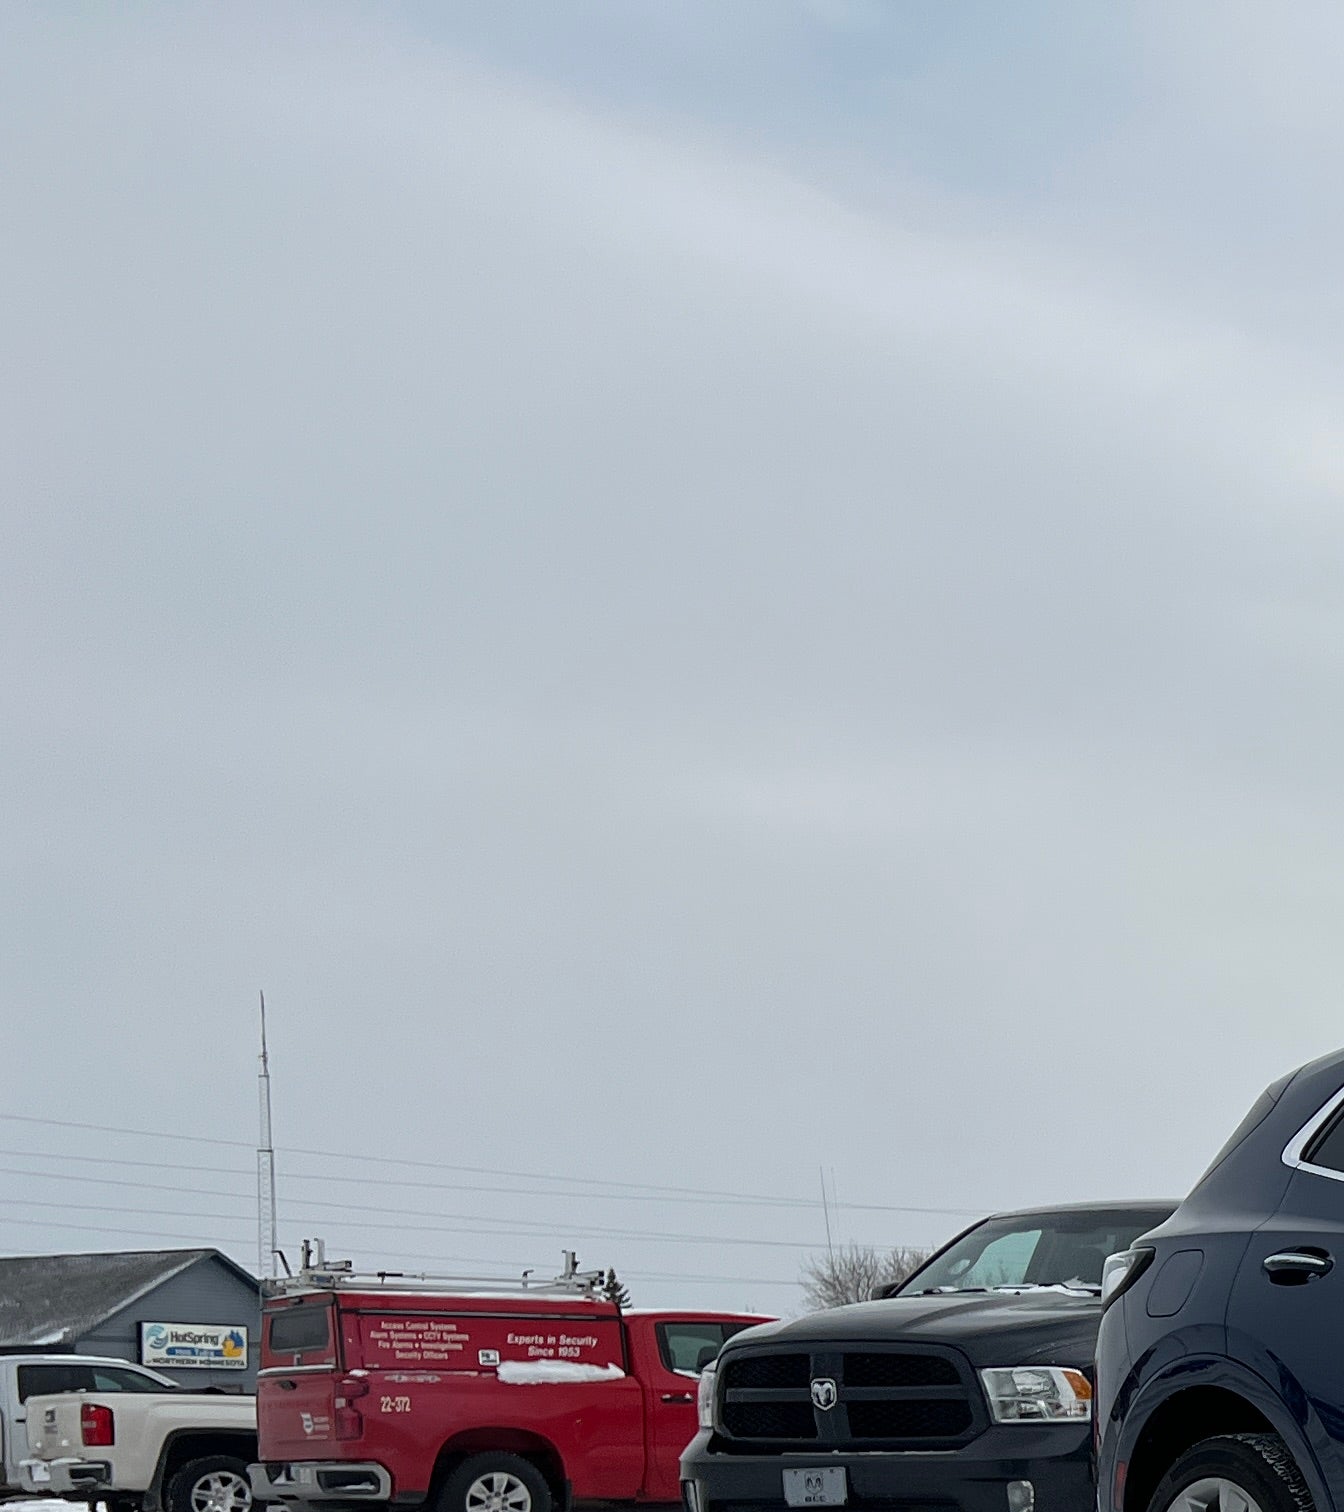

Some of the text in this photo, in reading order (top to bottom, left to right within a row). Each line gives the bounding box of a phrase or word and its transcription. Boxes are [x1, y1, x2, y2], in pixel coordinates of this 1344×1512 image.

[507, 1332, 599, 1349] Experts in Security
[528, 1345, 555, 1357] Since
[380, 1396, 412, 1413] 22-372
